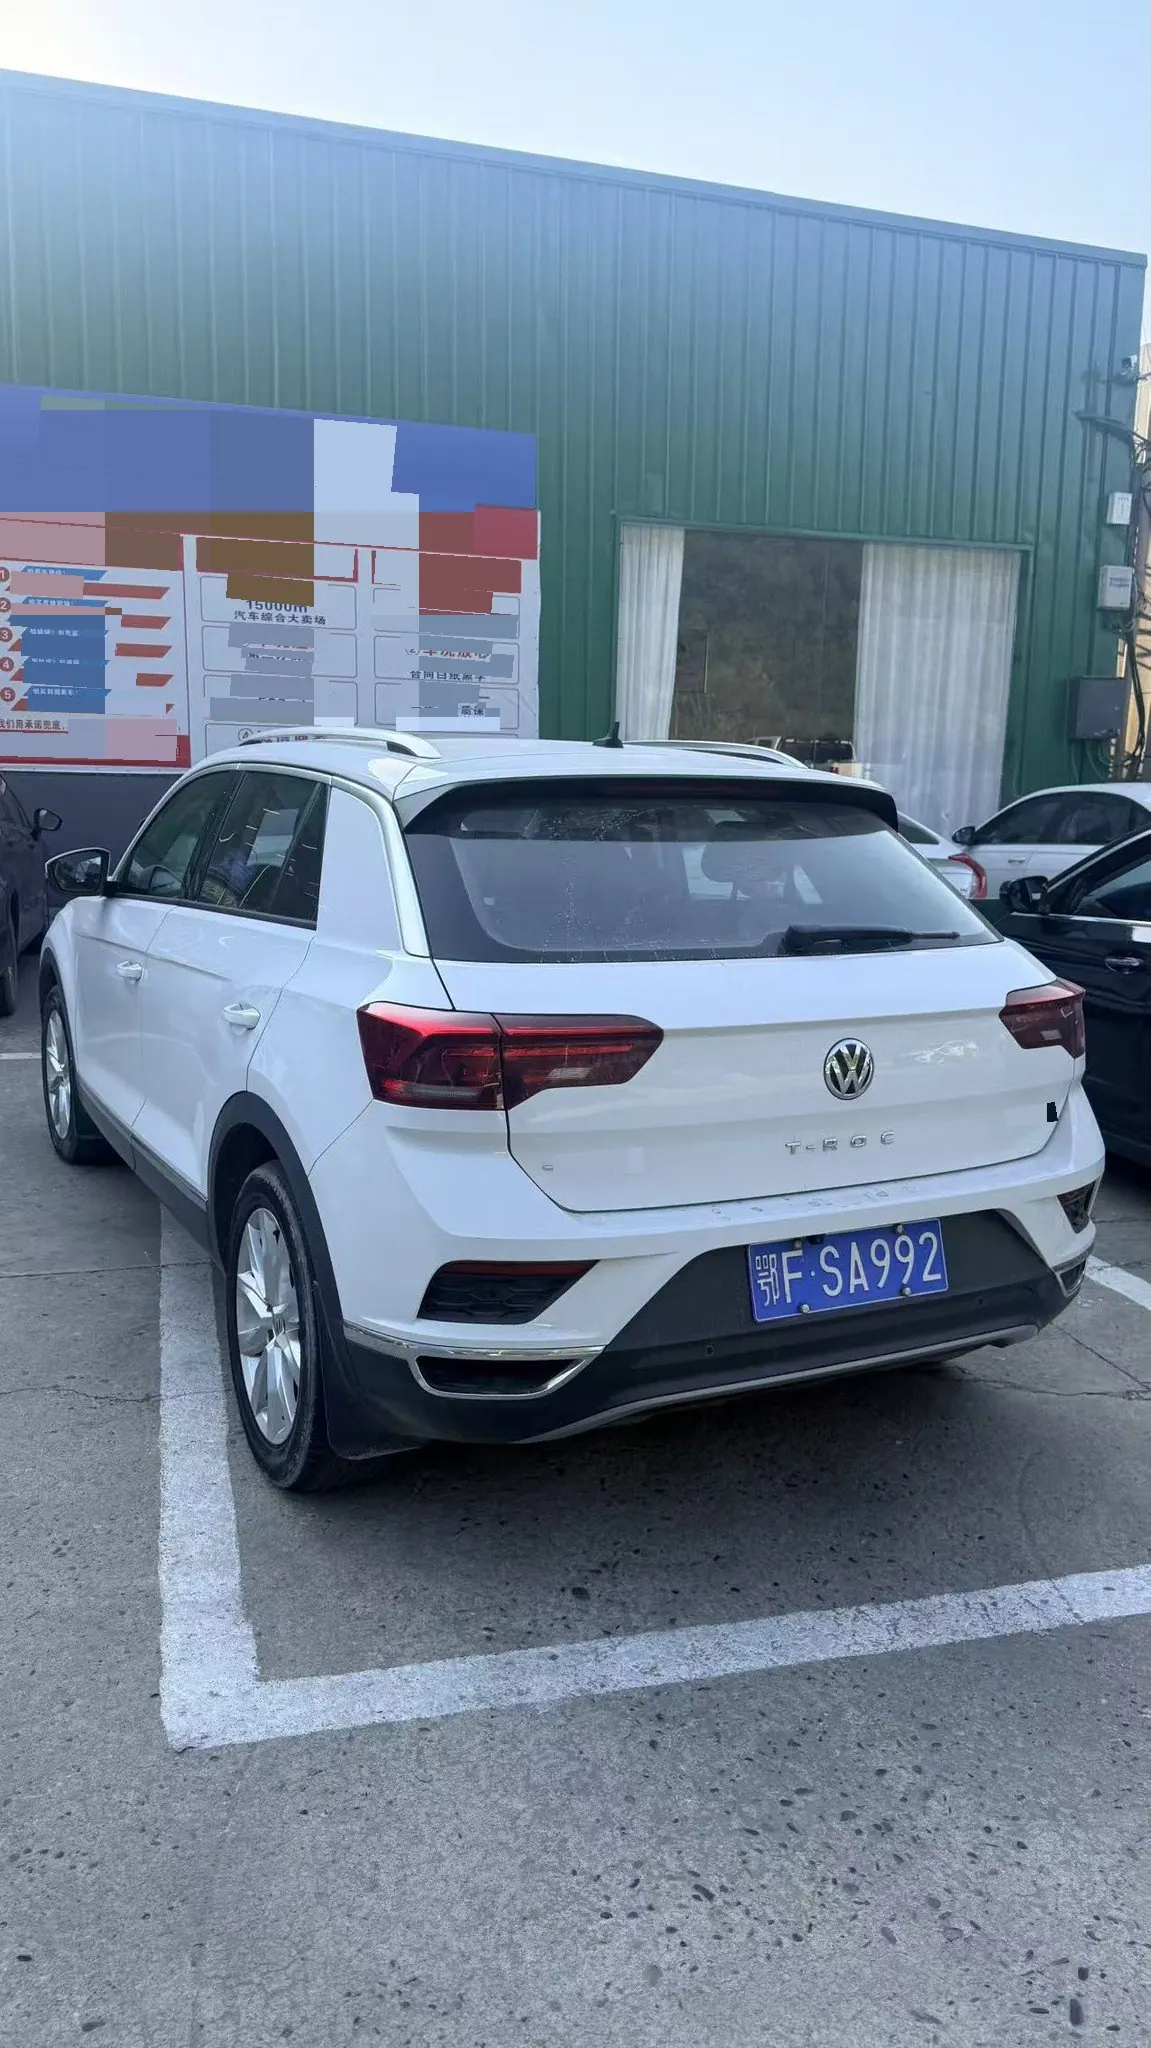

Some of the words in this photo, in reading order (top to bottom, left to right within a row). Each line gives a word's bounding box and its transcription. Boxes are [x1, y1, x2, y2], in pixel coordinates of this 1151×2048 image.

[234, 610, 326, 626] 汽车综合大卖场
[785, 1131, 895, 1155] T-ROC
